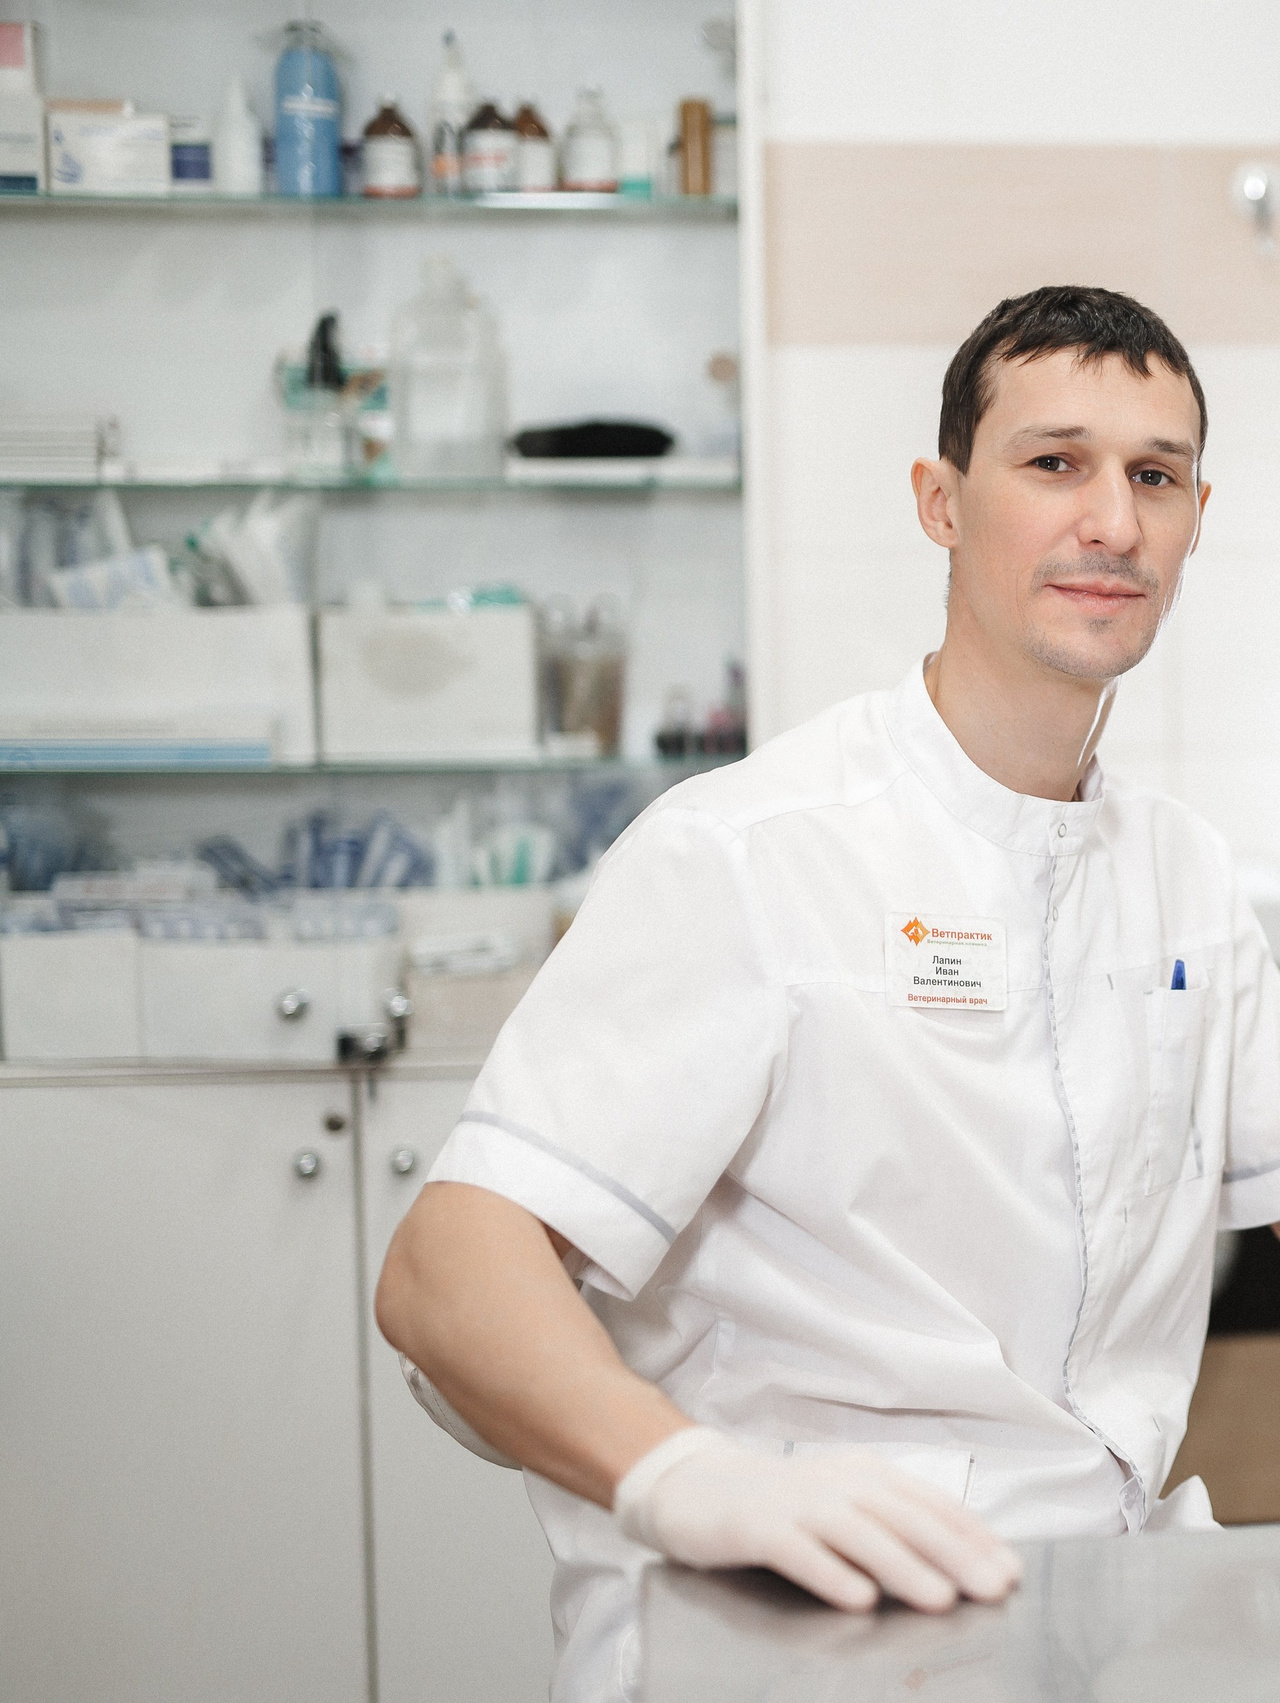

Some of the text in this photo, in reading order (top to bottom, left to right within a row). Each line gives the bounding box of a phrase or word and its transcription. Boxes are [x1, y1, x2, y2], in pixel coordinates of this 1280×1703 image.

[931, 928, 993, 941] Ветпрактик
[932, 955, 962, 966] Лапин
[935, 966, 959, 976] Иван
[913, 976, 982, 988] Валентинович
[907, 993, 988, 1006] Ветеринарный врач
